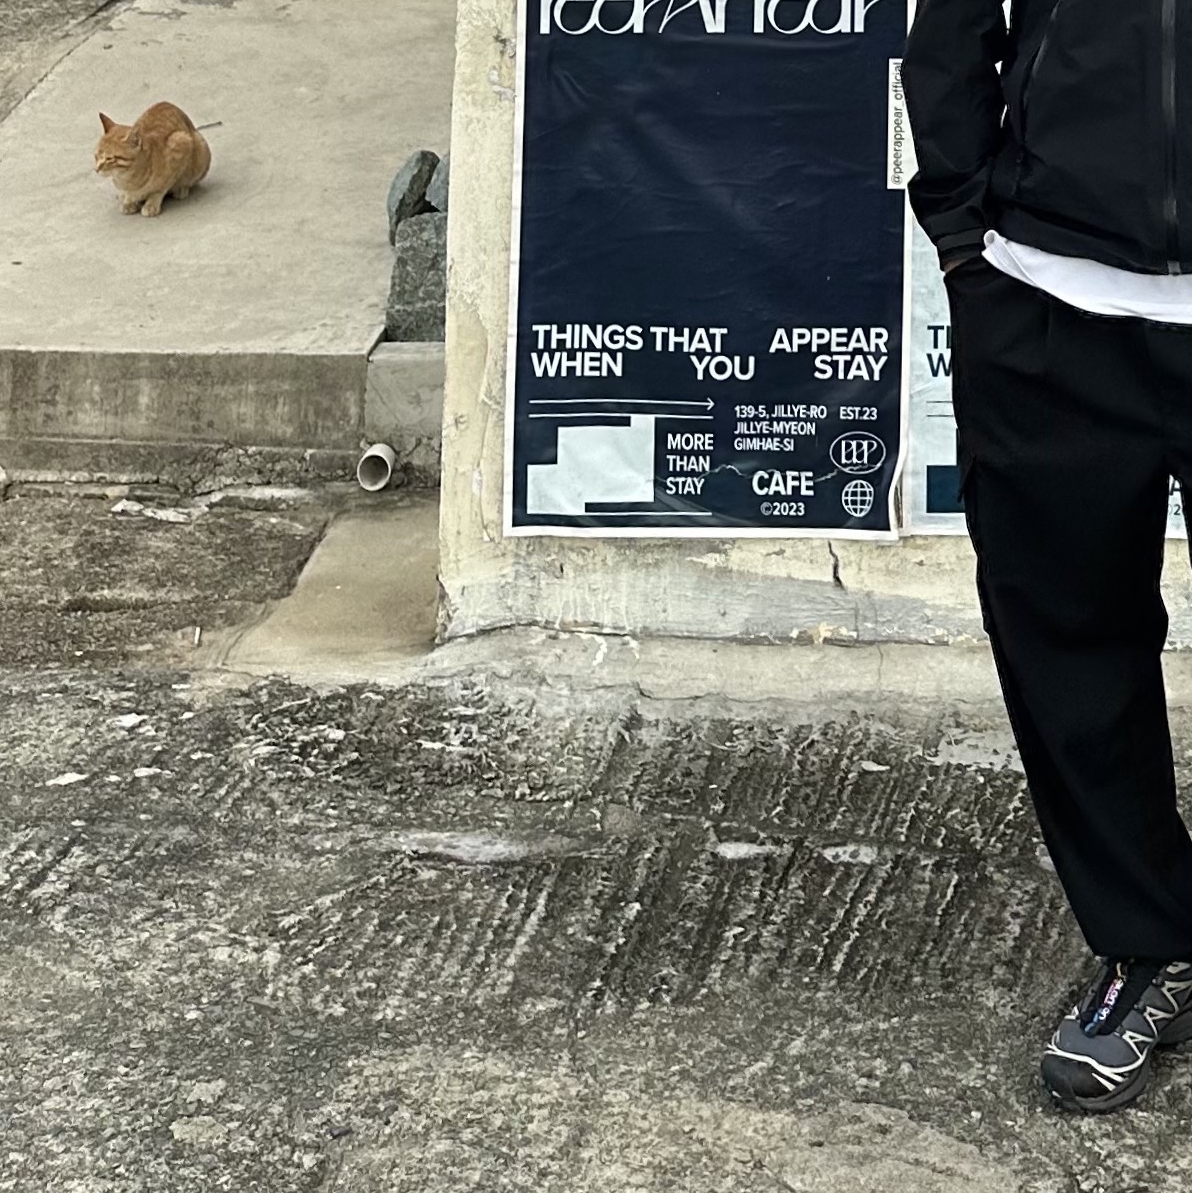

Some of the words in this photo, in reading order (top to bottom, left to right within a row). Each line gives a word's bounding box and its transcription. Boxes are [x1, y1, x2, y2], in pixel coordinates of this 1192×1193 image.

[532, 324, 643, 350] THINGS
[650, 327, 727, 352] THAT
[770, 328, 888, 352] APPEAR
[531, 352, 622, 377] WHEN
[690, 355, 754, 380] YOU
[814, 355, 887, 380] STAY
[735, 405, 769, 419] 139-5,
[772, 405, 827, 419] JILLYE-RO
[840, 406, 877, 420] EST.23
[734, 421, 815, 435] JILLYE-MYEON
[668, 434, 713, 450] MORE
[734, 438, 794, 451] GIMHAE-SI
[666, 455, 711, 472] THAN
[666, 478, 705, 495] STAY
[752, 471, 814, 497] CAFE
